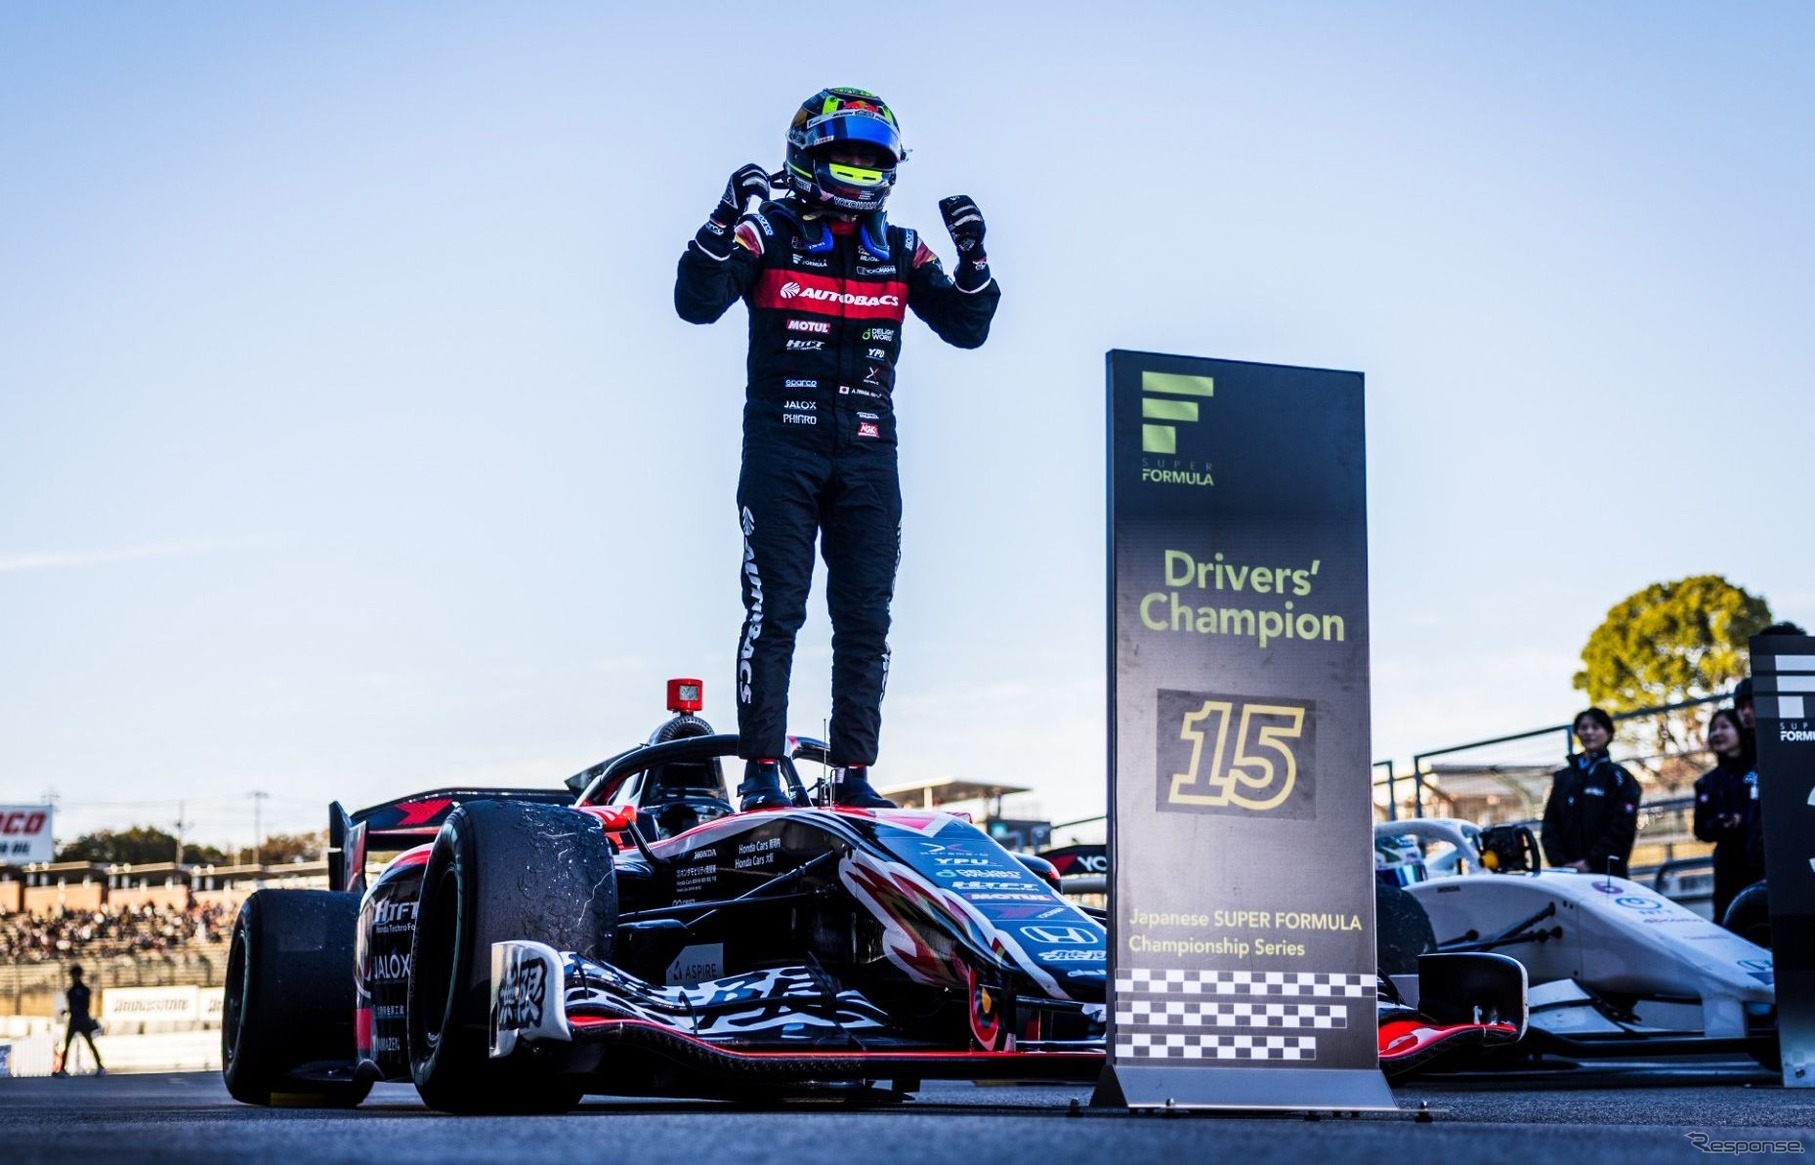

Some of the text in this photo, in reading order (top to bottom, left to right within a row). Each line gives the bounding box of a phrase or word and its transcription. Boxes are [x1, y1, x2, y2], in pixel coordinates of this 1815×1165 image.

[799, 287, 899, 307] AUTOBACS
[788, 319, 829, 333] MOTUL
[783, 400, 818, 411] JALOX
[1141, 468, 1215, 487] FORMULA
[1139, 591, 1345, 649] Champion
[1168, 700, 1306, 811] 15
[1128, 907, 1363, 932] Japanese SUPER FORMULA
[1128, 934, 1250, 959] Championship
[1253, 938, 1306, 957] Series
[374, 953, 412, 979] JALOX
[685, 963, 718, 980] ASPIRE
